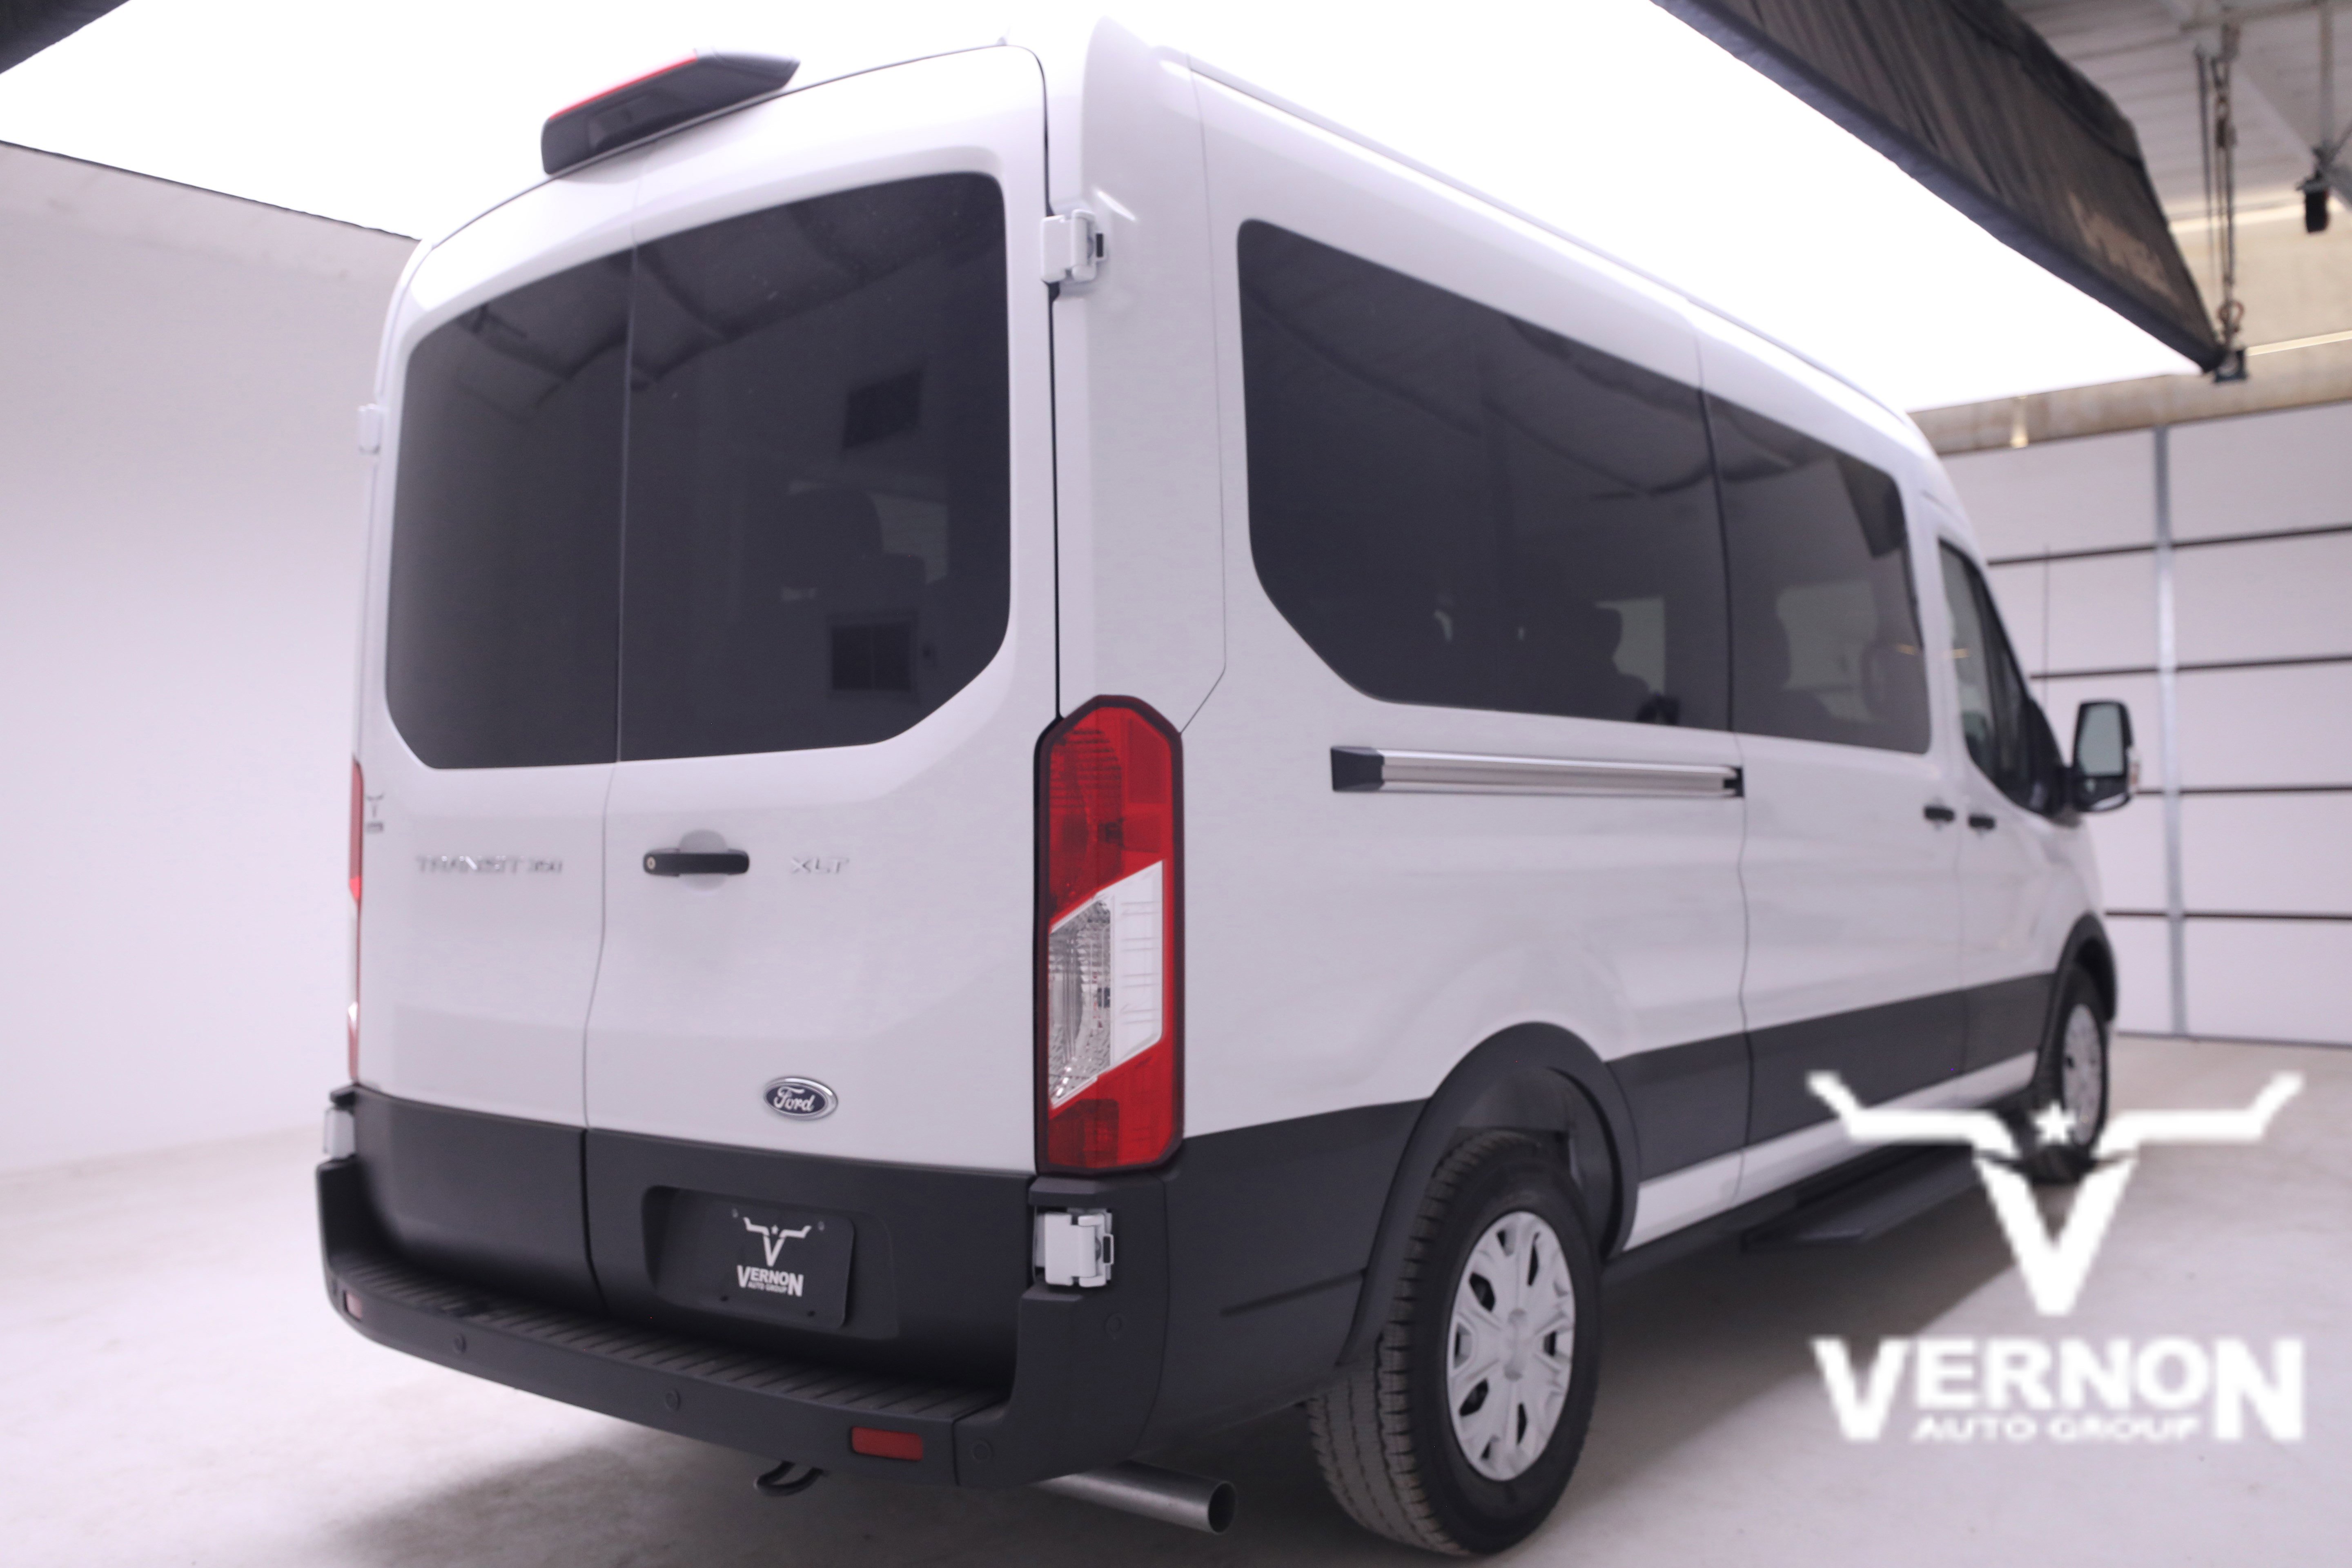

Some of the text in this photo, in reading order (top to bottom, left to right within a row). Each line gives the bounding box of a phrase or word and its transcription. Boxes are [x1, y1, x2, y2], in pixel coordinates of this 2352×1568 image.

[415, 855, 525, 875] TRANSIT
[792, 857, 851, 874] XLT
[773, 1086, 816, 1112] Ford
[737, 1265, 804, 1297] VERNON
